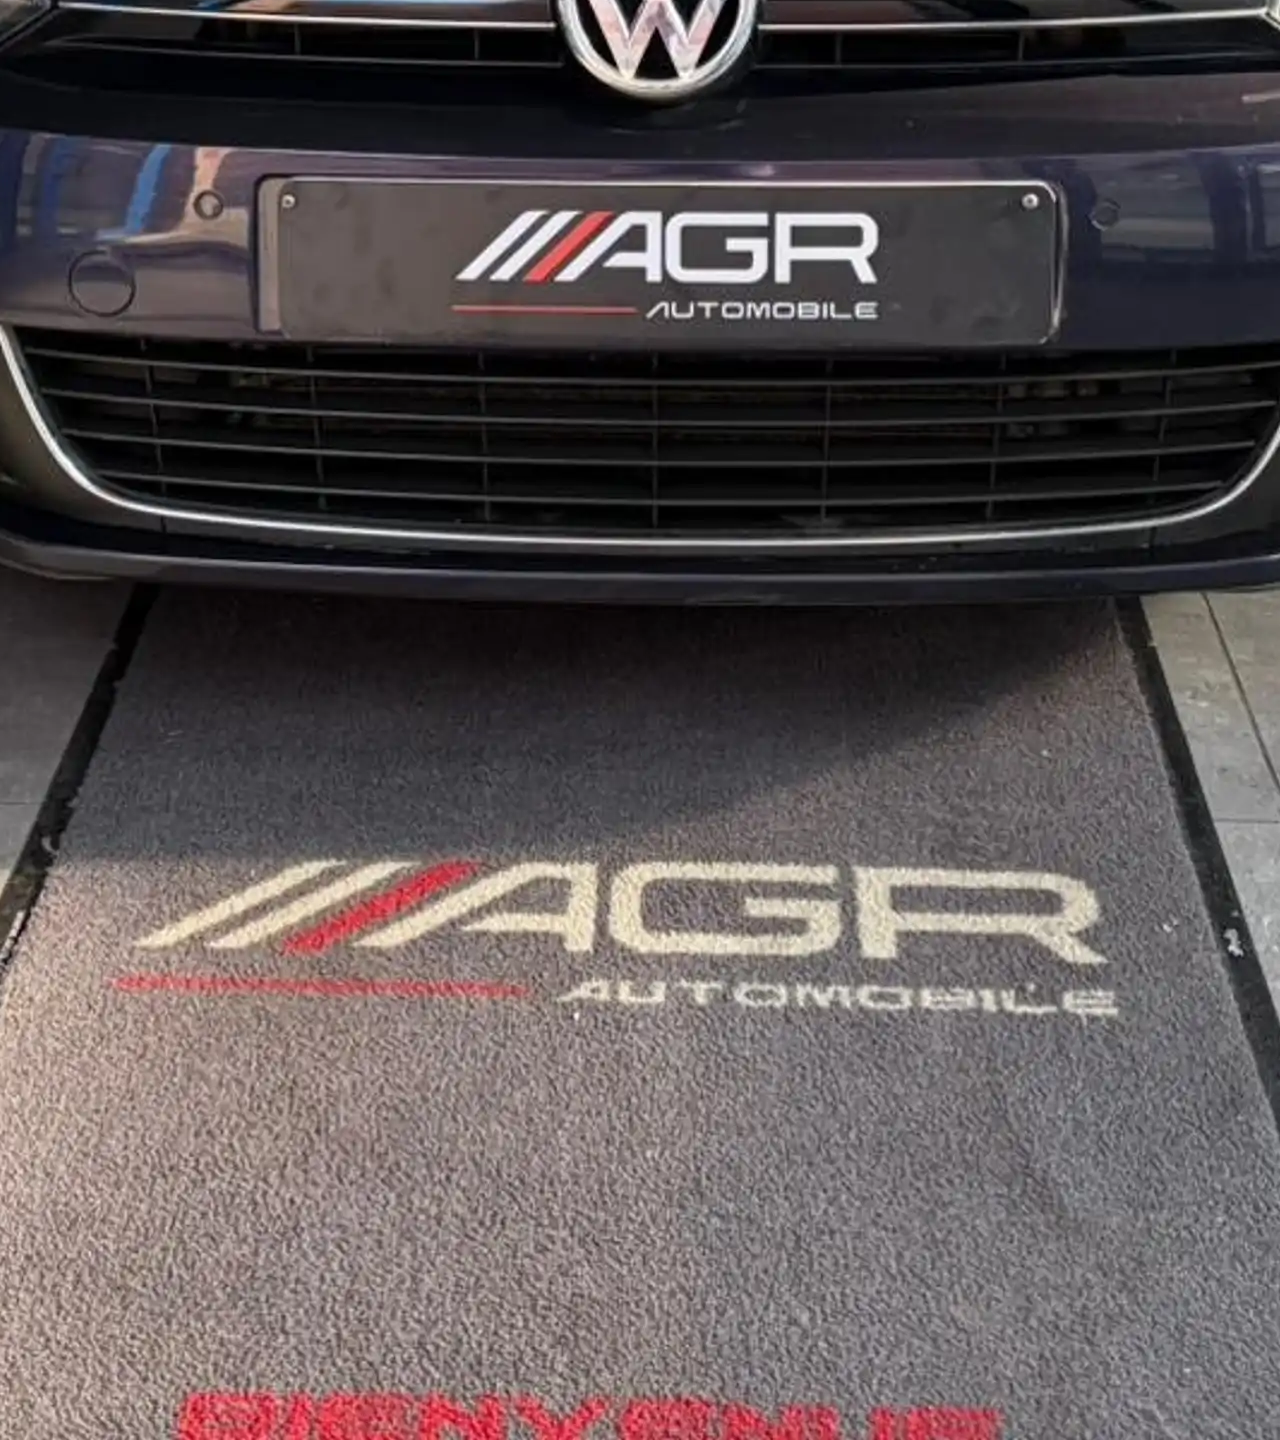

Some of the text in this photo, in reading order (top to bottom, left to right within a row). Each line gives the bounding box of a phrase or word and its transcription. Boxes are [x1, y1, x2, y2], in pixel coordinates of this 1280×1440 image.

[553, 210, 880, 284] AGR
[645, 301, 879, 320] AUTOMOBILE
[350, 860, 1109, 965] AGR
[557, 976, 1120, 1016] AUTOMOBILE
